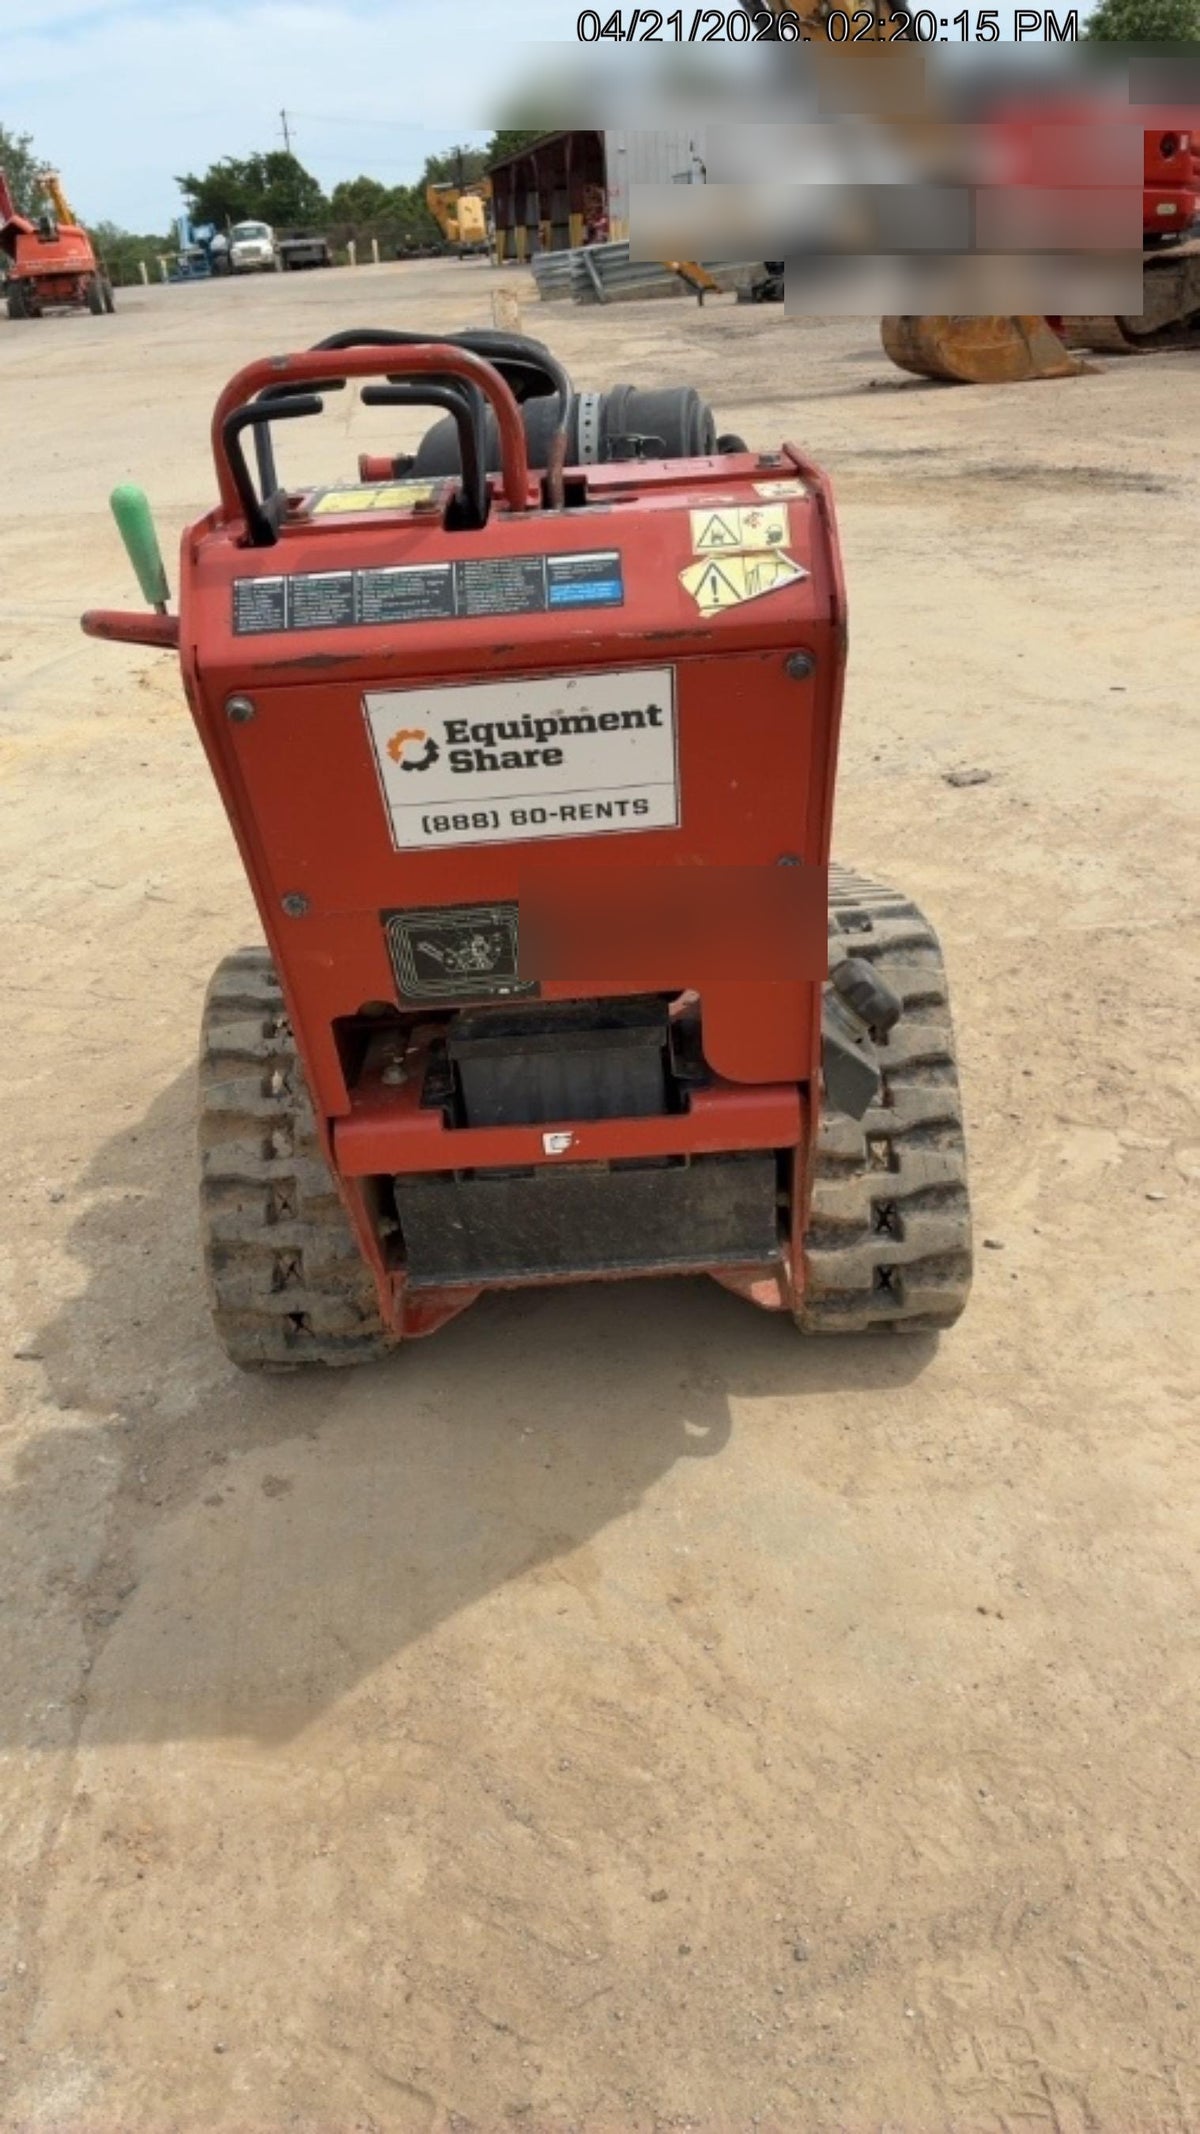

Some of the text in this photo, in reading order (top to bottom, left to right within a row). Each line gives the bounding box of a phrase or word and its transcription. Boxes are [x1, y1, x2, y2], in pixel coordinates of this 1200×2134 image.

[443, 704, 663, 746] Equipment
[448, 747, 564, 775] Share
[421, 798, 651, 835] (888) 80-RENTS
